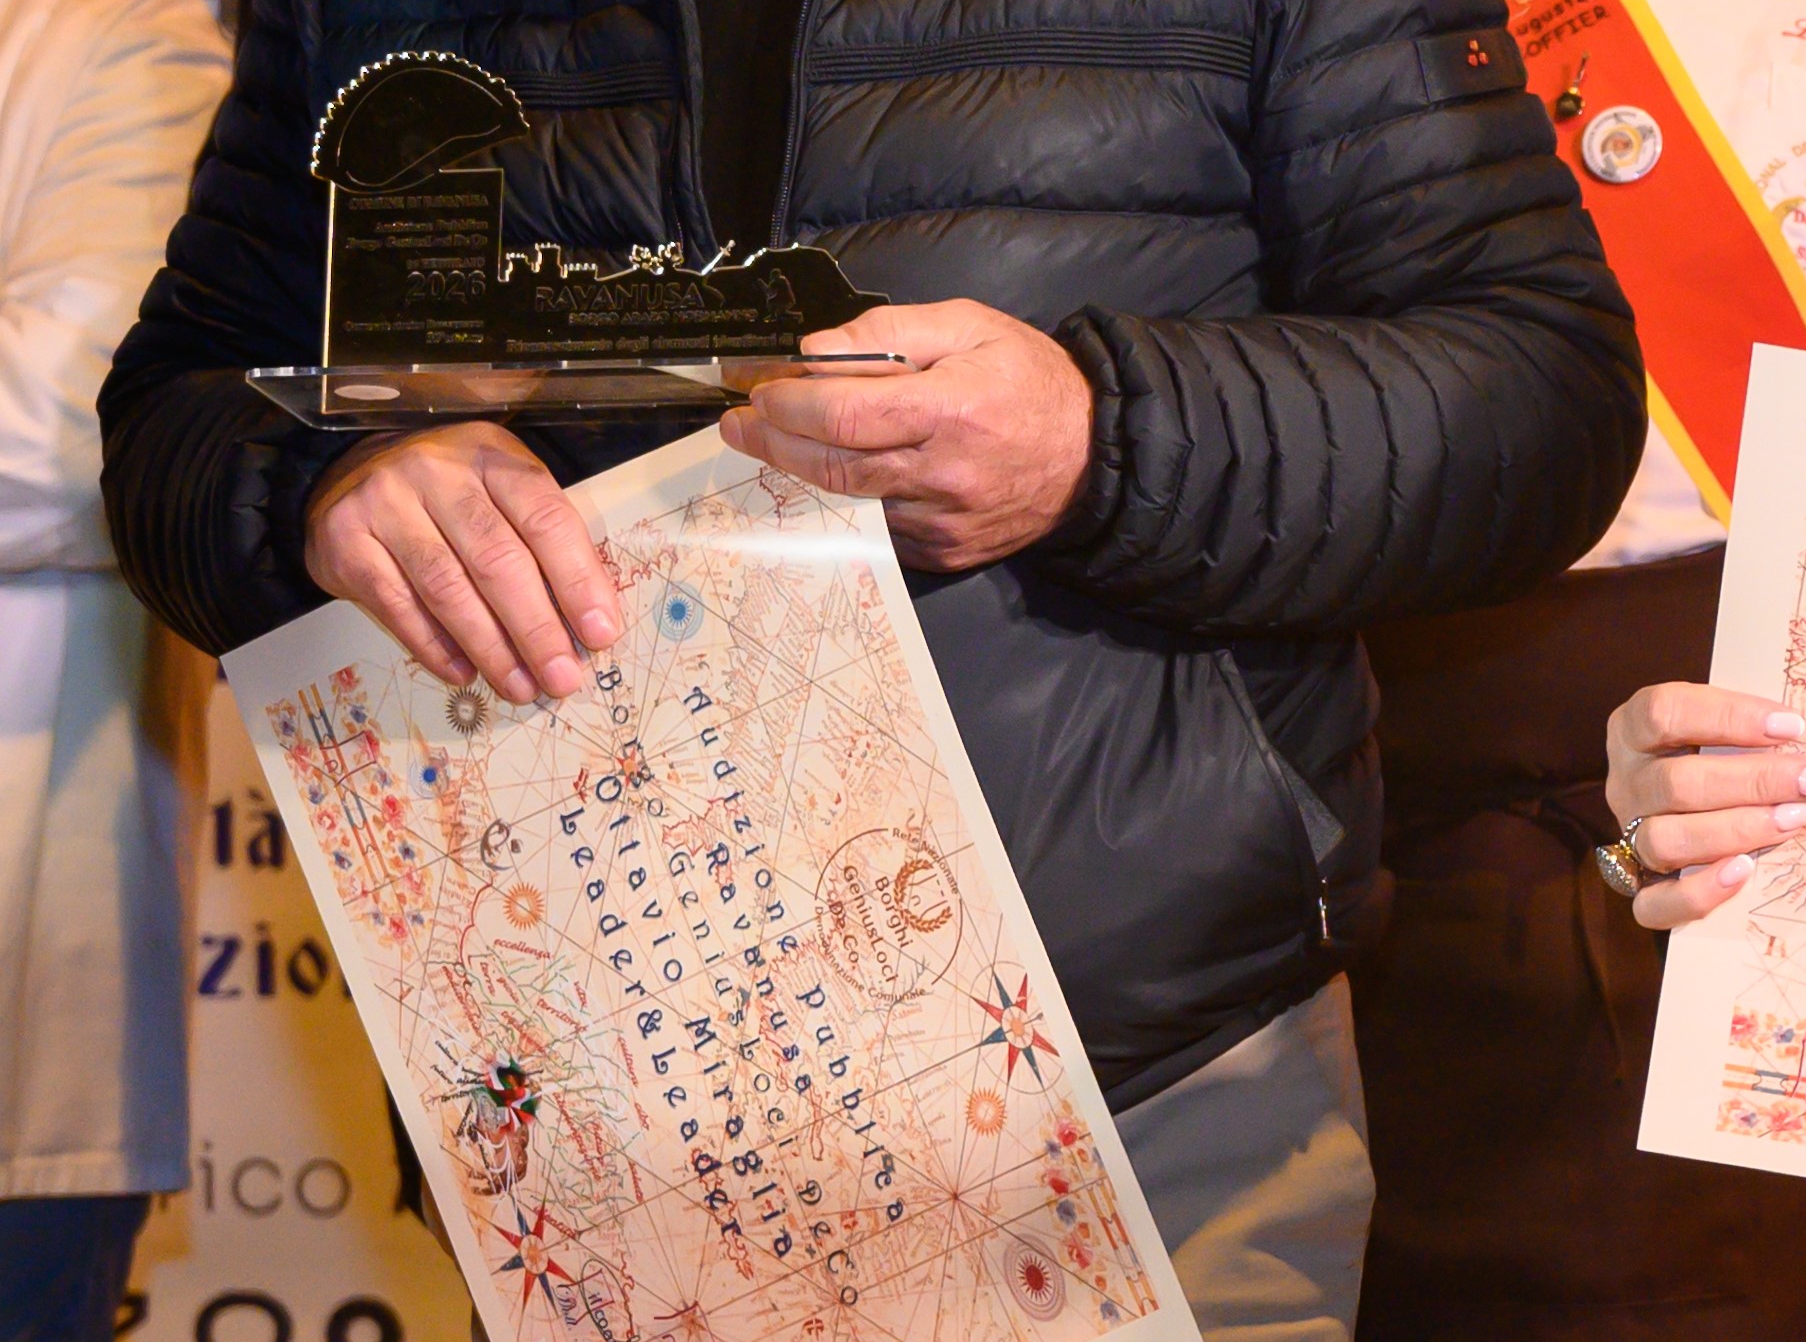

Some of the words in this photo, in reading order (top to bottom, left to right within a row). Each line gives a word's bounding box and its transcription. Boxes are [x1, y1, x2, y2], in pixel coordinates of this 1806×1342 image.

[1525, 5, 1608, 58] OFFIER
[405, 270, 486, 304] 2026
[535, 281, 705, 311] RAVANUSA
[596, 664, 666, 818] Borgo
[683, 686, 799, 955] Audizione
[891, 827, 920, 846] Rete
[492, 937, 555, 961] eccellenza
[843, 864, 900, 984] GeniusLoci
[874, 875, 914, 949] Borghi
[705, 841, 813, 1095] Ravanusa
[560, 806, 743, 1237] Leader&Leader
[595, 775, 683, 982] Ottavio
[684, 1015, 793, 1259] Miraglia
[587, 1291, 602, 1307] il
